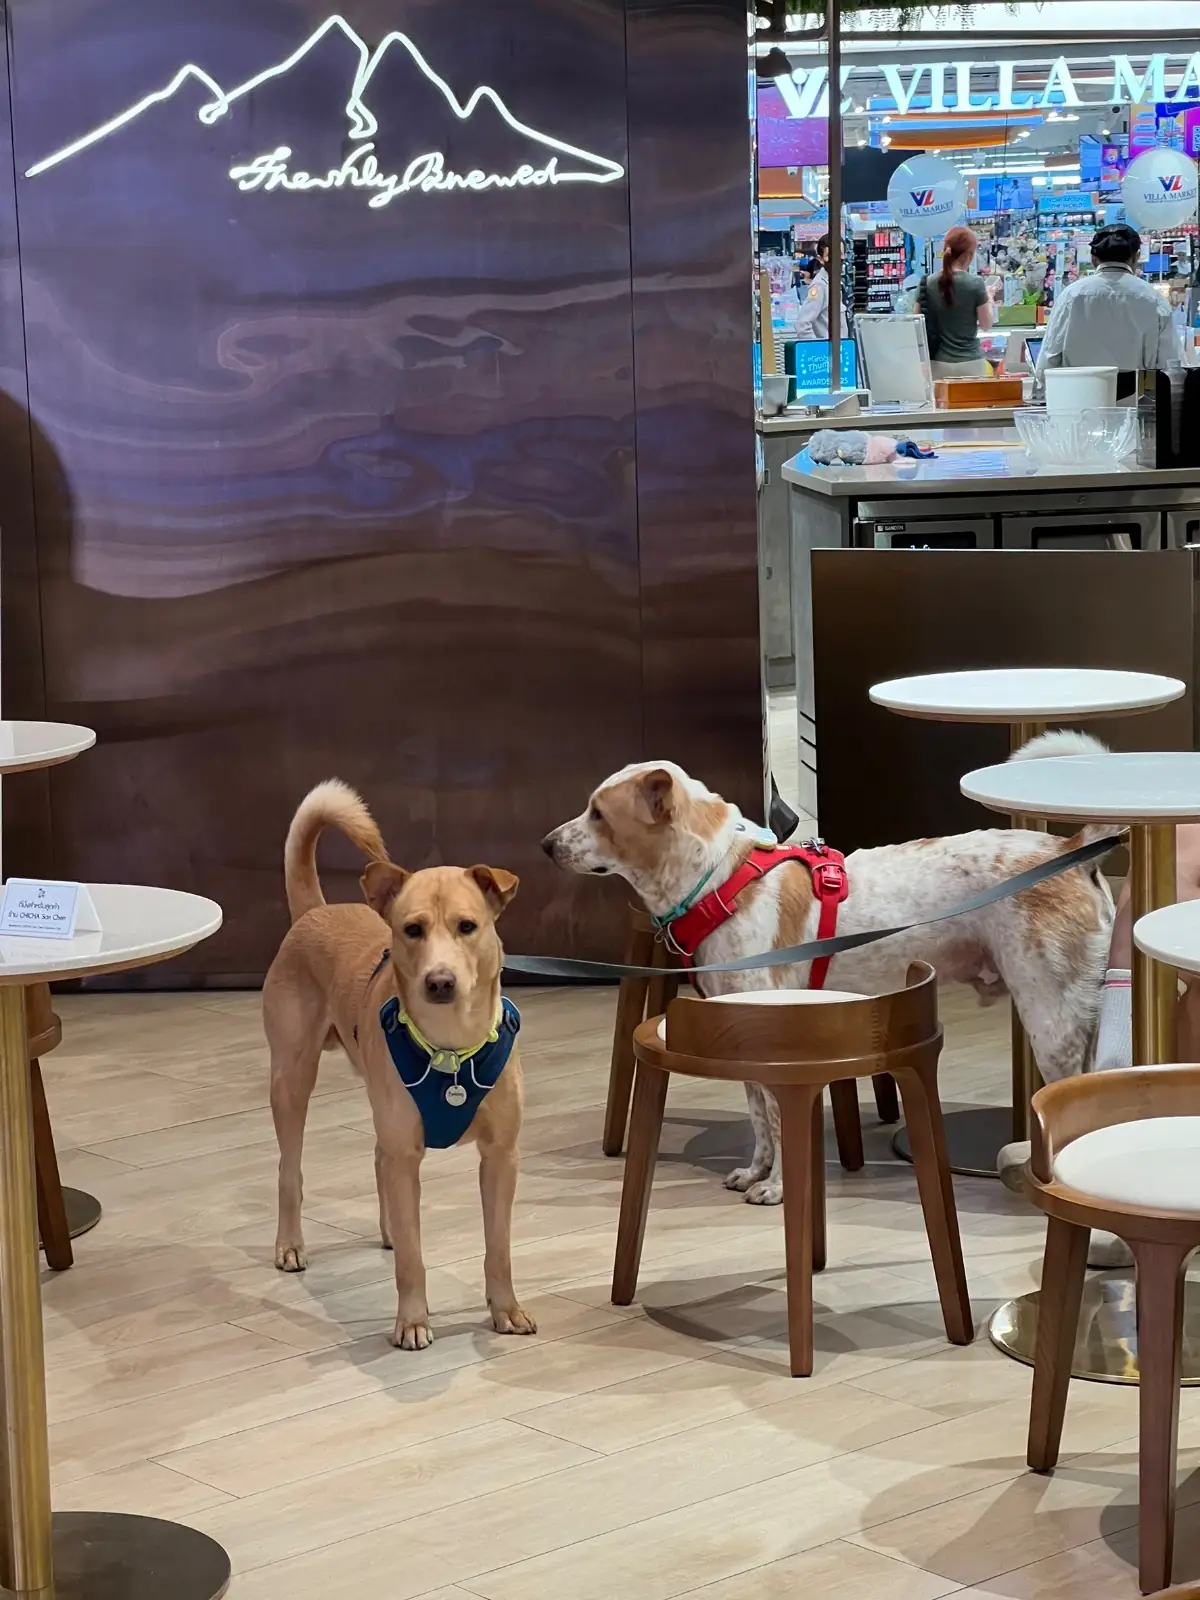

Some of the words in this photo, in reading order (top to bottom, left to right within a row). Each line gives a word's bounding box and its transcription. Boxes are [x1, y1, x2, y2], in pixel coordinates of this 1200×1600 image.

[878, 56, 1085, 114] VILLA
[1107, 51, 1200, 105] MA
[402, 151, 559, 193] Brewed
[968, 188, 976, 198] 4
[1143, 193, 1167, 201] VILLA
[899, 207, 920, 215] VILLA
[921, 200, 955, 214] MARKET
